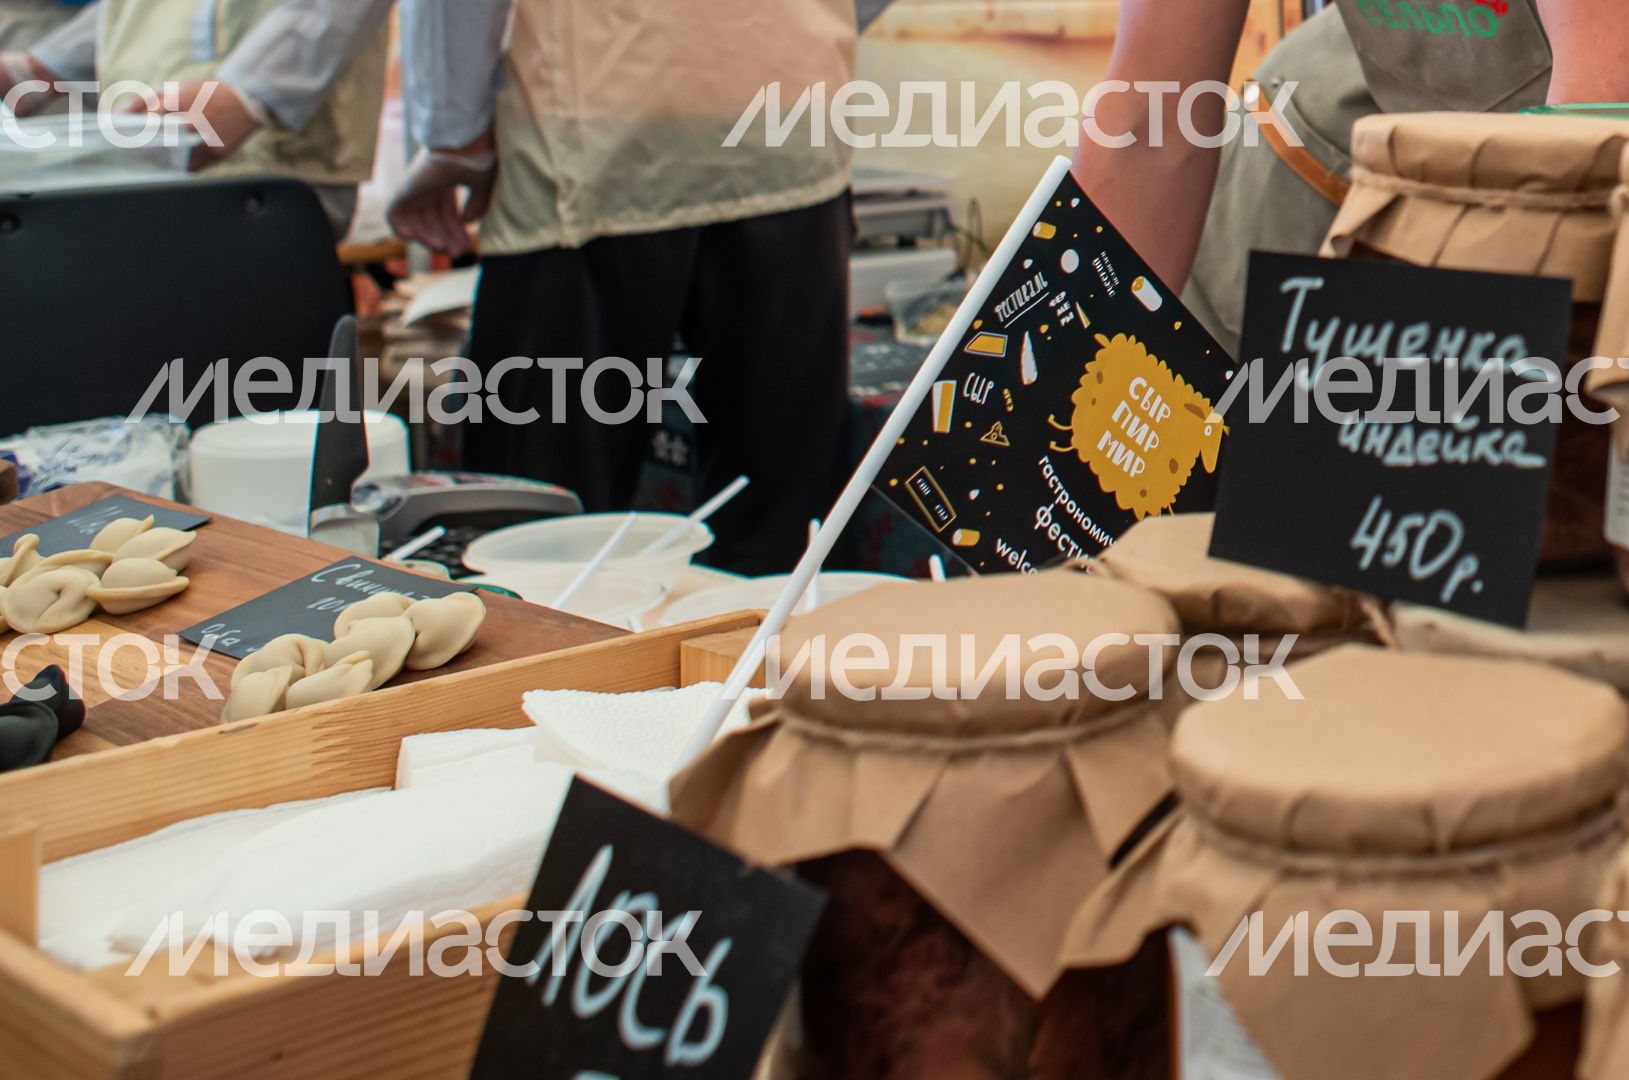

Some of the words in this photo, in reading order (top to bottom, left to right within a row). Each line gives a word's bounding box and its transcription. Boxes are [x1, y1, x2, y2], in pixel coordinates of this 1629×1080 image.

[1280, 276, 1560, 392] Тушенка
[963, 372, 994, 405] СЫР
[1128, 376, 1172, 423] СЫР
[1111, 399, 1161, 453] ПИР
[1338, 412, 1548, 469] индейка
[1096, 430, 1147, 478] МИР
[1351, 495, 1485, 604] 450р.
